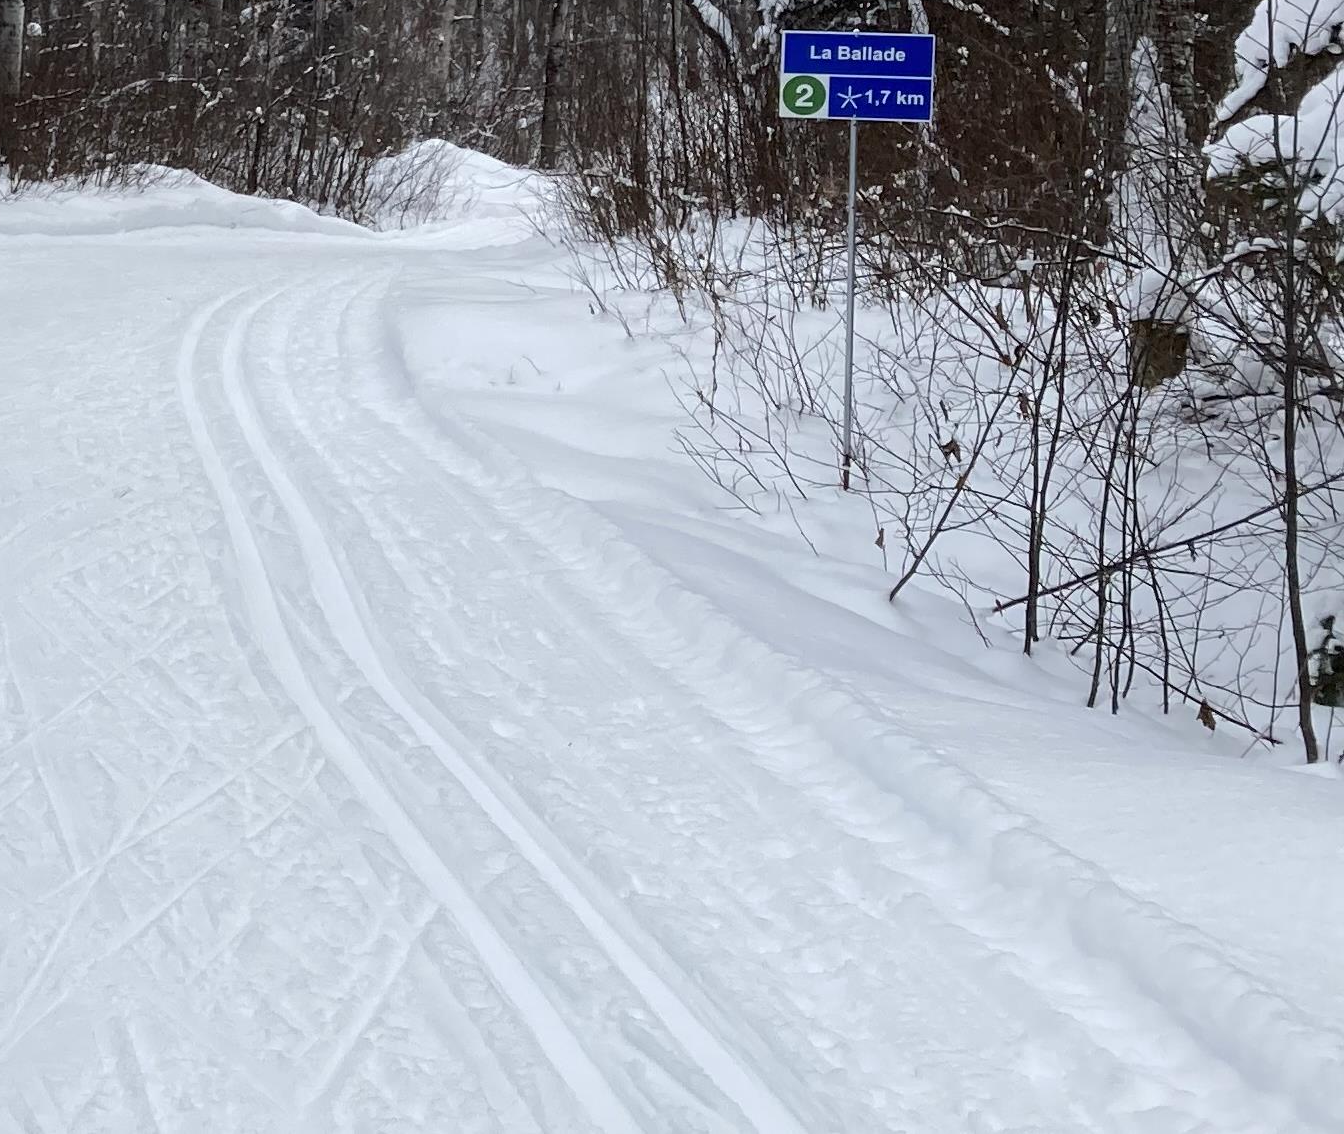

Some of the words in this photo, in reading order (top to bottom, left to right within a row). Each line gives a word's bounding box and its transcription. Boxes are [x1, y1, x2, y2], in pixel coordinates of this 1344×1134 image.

[810, 45, 832, 60] La
[837, 45, 906, 62] Ballade
[794, 83, 814, 107] 2
[864, 89, 891, 106] 1,7
[896, 90, 924, 106] km
